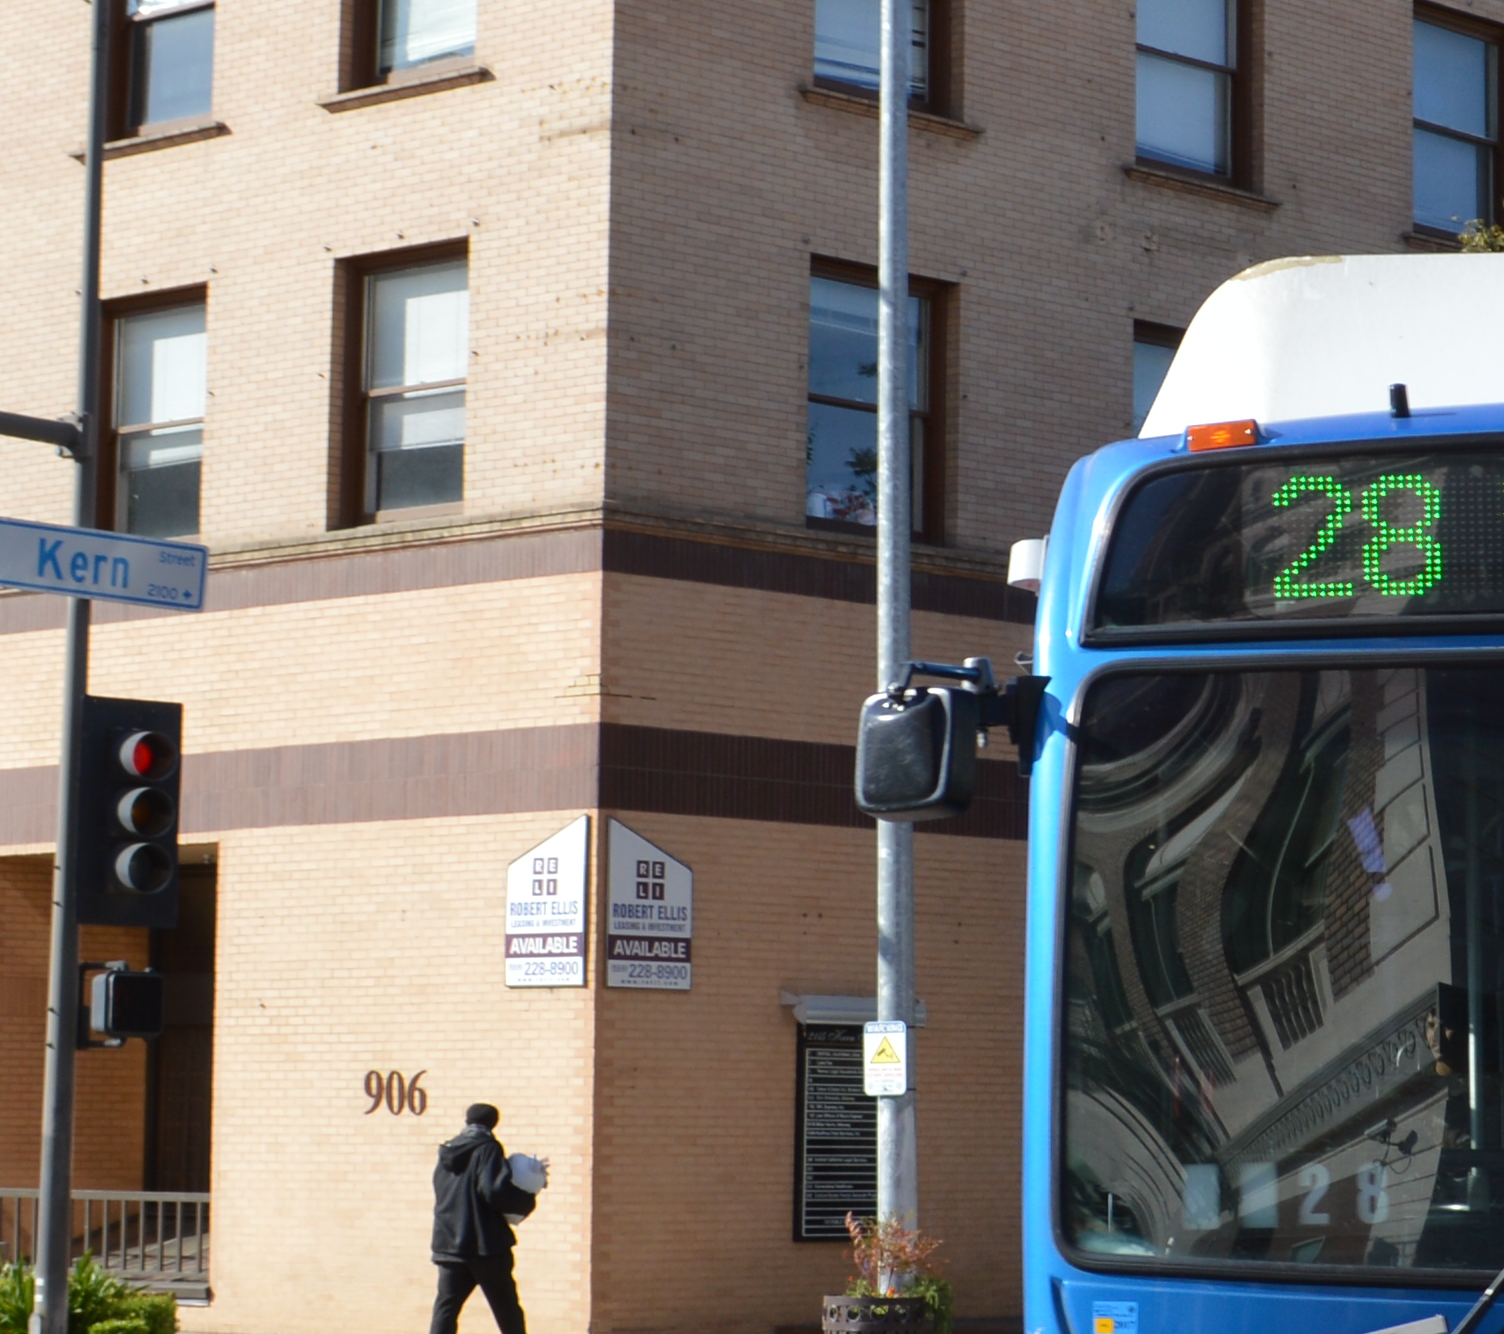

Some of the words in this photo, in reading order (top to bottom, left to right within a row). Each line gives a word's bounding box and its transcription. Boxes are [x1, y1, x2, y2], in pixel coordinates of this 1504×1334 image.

[1272, 473, 1442, 598] 28
[36, 537, 130, 589] Kern
[158, 550, 195, 568] Street
[147, 583, 179, 601] 2100
[510, 901, 547, 916] ROBERT
[551, 900, 578, 915] ELLIS
[613, 903, 654, 919] ROBERT
[658, 905, 687, 921] ELLIS
[510, 936, 578, 954] AVAILABLE
[613, 939, 687, 958] AVAILABLE
[524, 961, 578, 976] 228-8900
[628, 963, 688, 980] 228-8900
[364, 1069, 428, 1116] 906
[1299, 1162, 1391, 1225] 28
